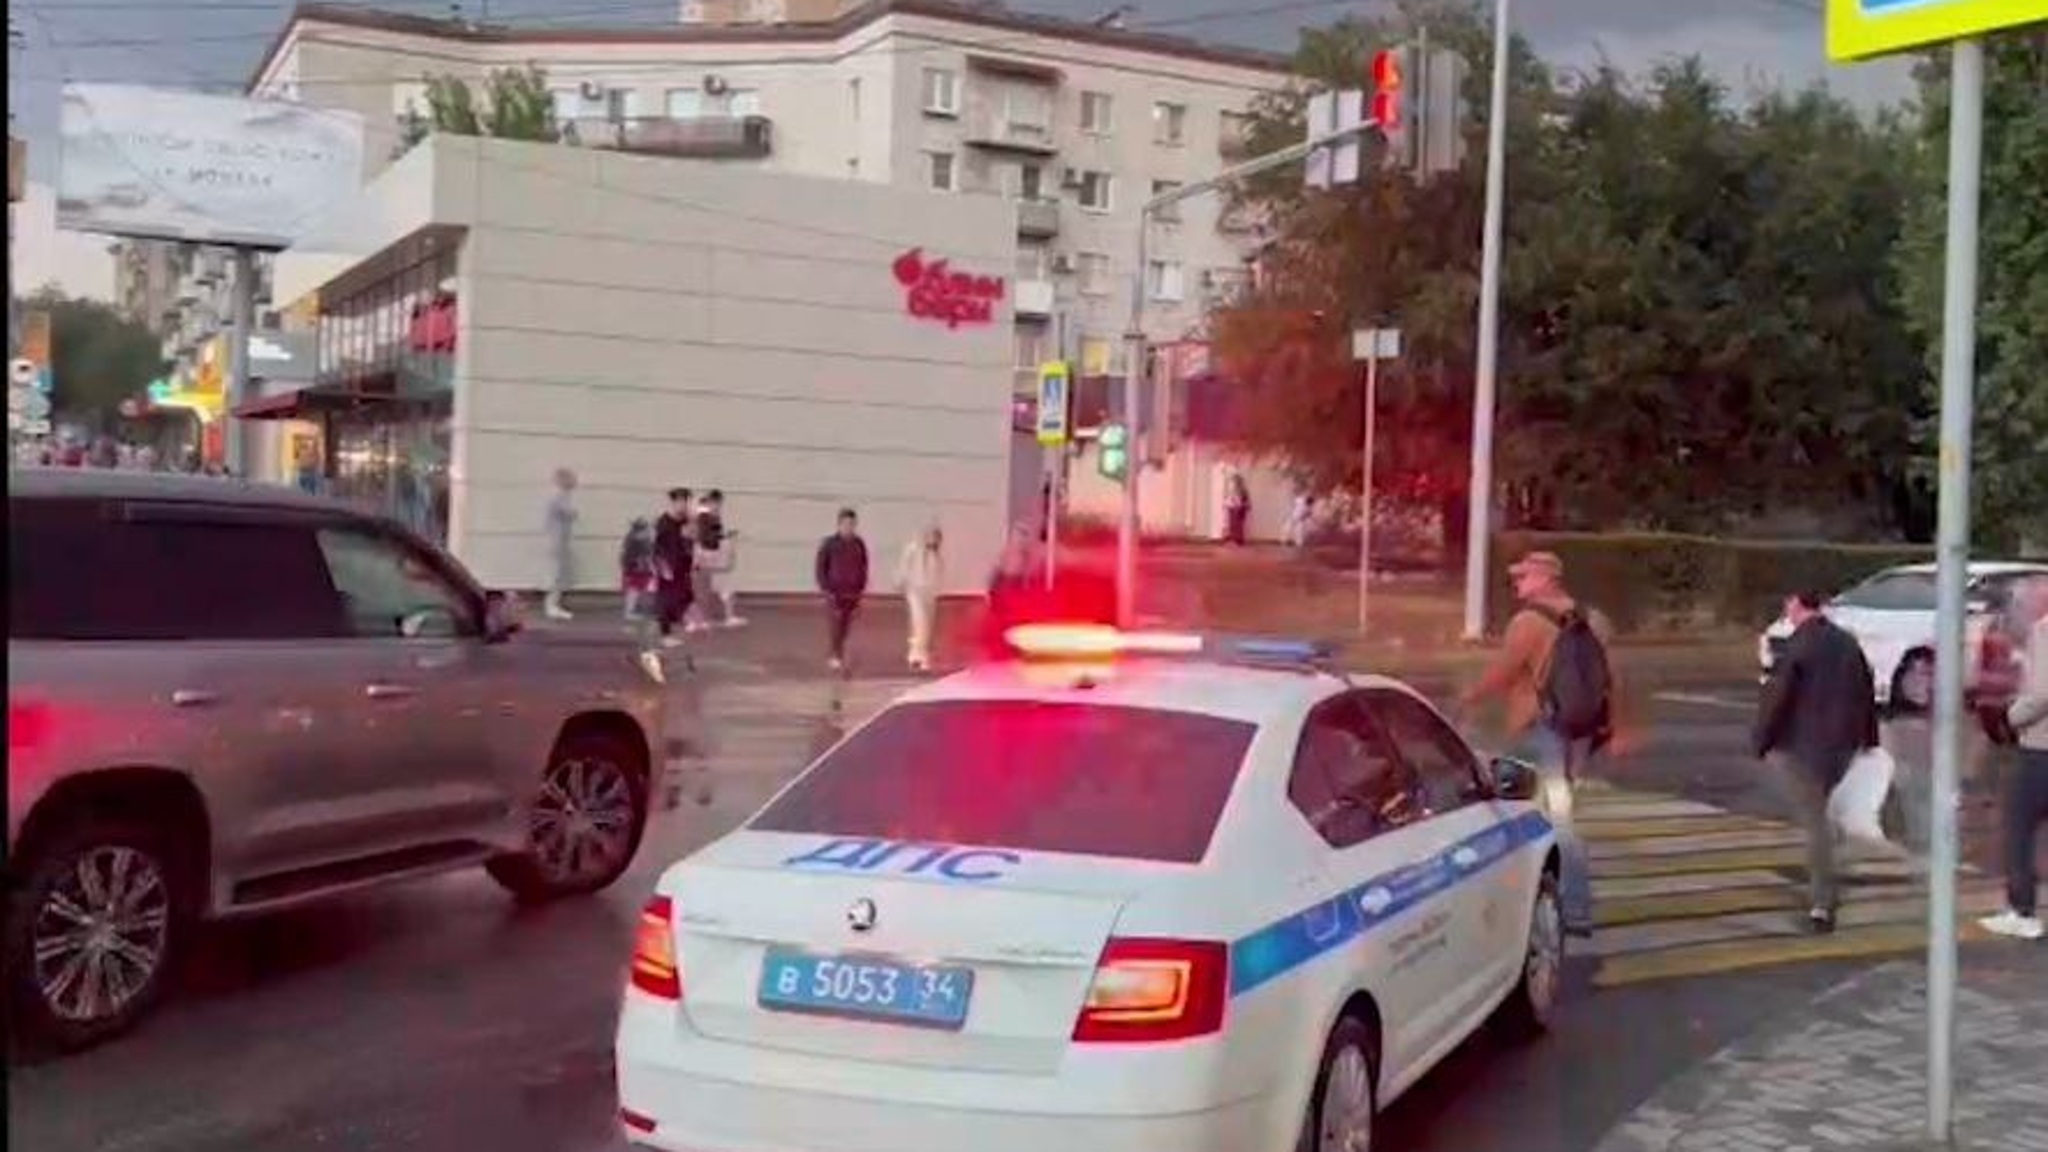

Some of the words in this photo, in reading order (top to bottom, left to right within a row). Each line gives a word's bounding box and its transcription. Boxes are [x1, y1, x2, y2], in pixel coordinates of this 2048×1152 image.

[783, 839, 1021, 880] ДПС
[811, 960, 900, 1005] 5053
[920, 969, 957, 1002] 34
